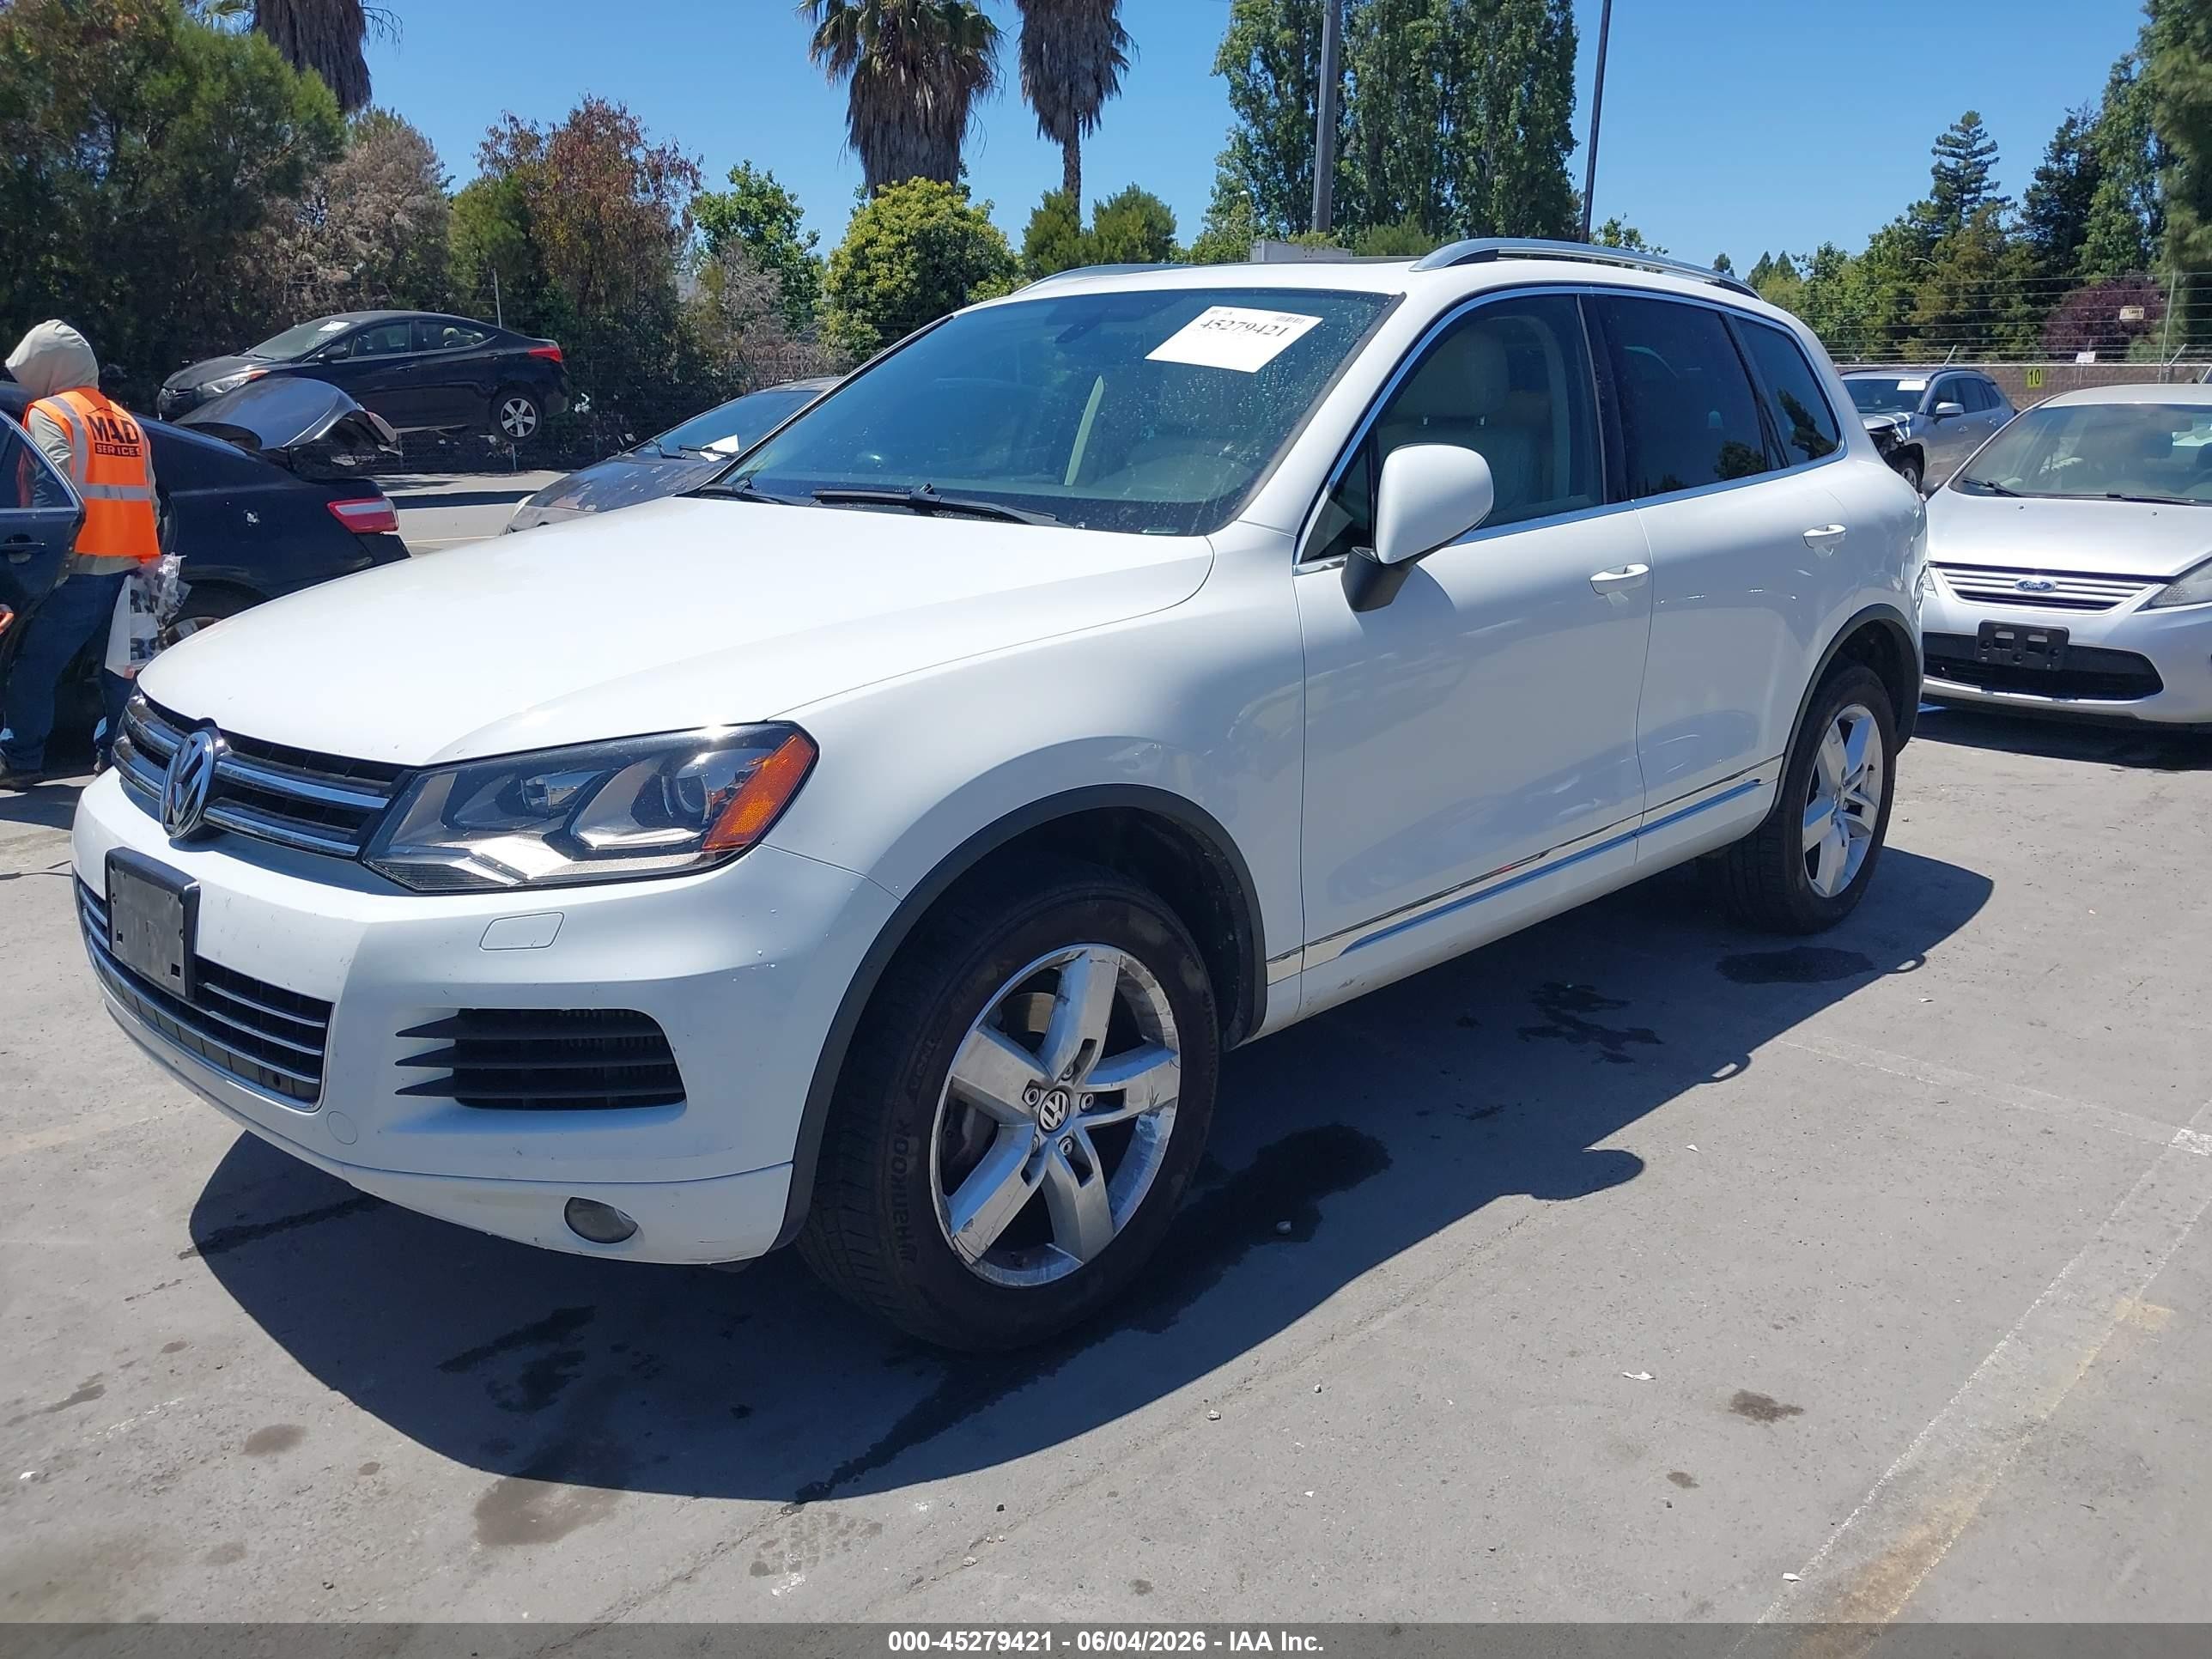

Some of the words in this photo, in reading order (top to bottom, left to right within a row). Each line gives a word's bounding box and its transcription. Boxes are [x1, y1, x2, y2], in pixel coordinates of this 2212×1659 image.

[1200, 319, 1290, 337] 45279421
[2028, 368, 2041, 385] 10
[85, 414, 140, 445] MAD
